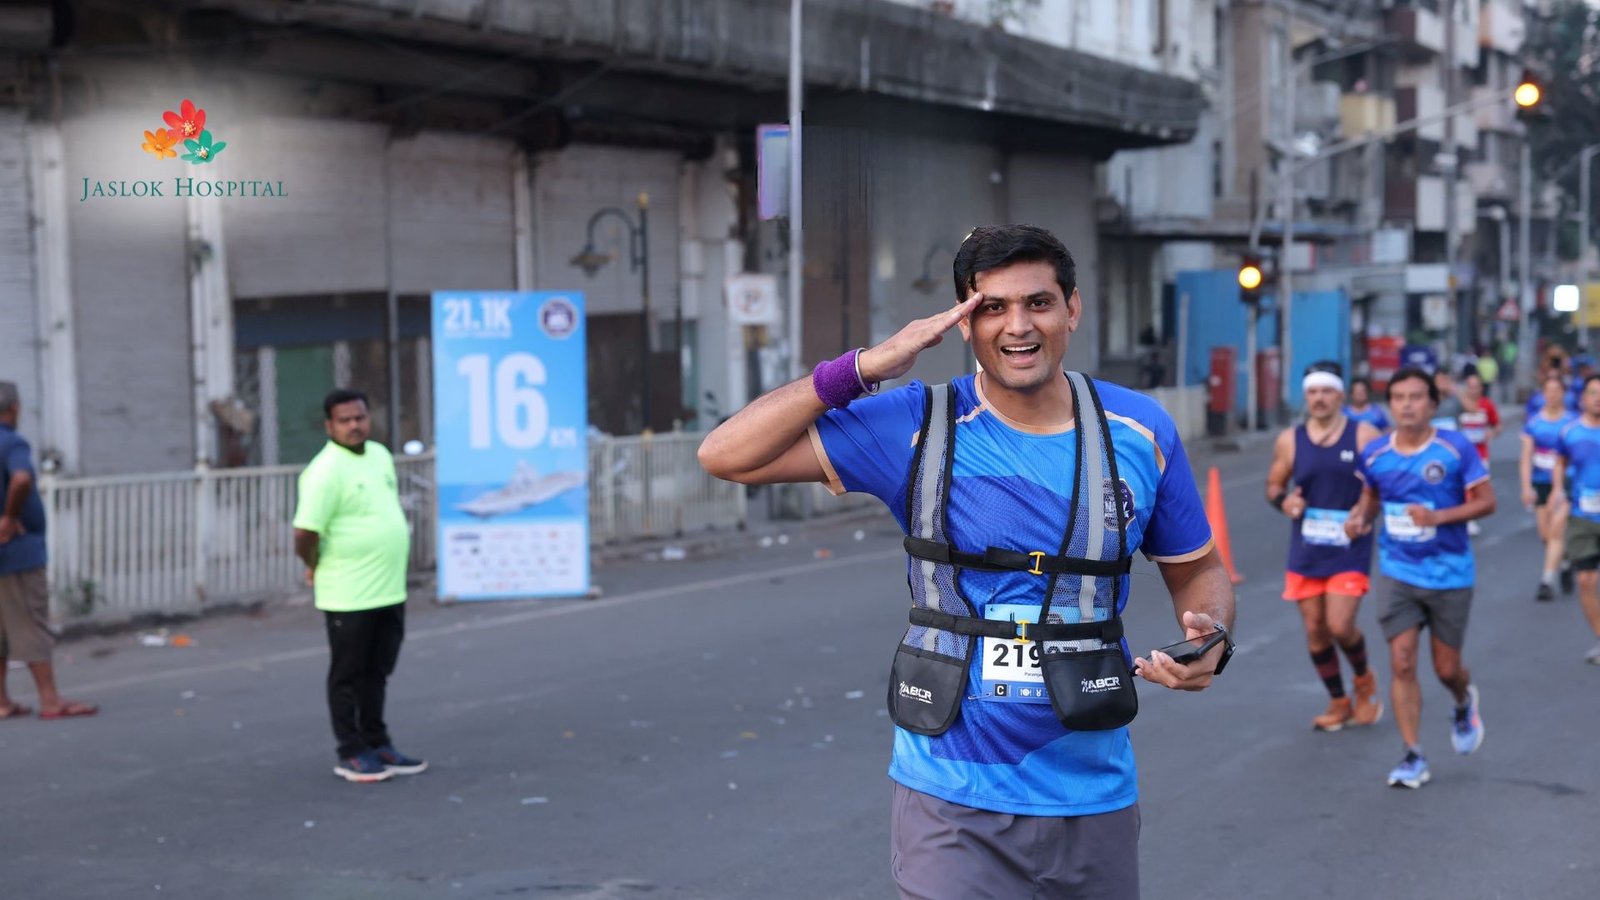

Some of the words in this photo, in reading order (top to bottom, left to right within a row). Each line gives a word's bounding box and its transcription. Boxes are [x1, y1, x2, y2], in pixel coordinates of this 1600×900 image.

[443, 298, 511, 332] 21.1K
[456, 352, 549, 450] 16
[996, 685, 1005, 696] C
